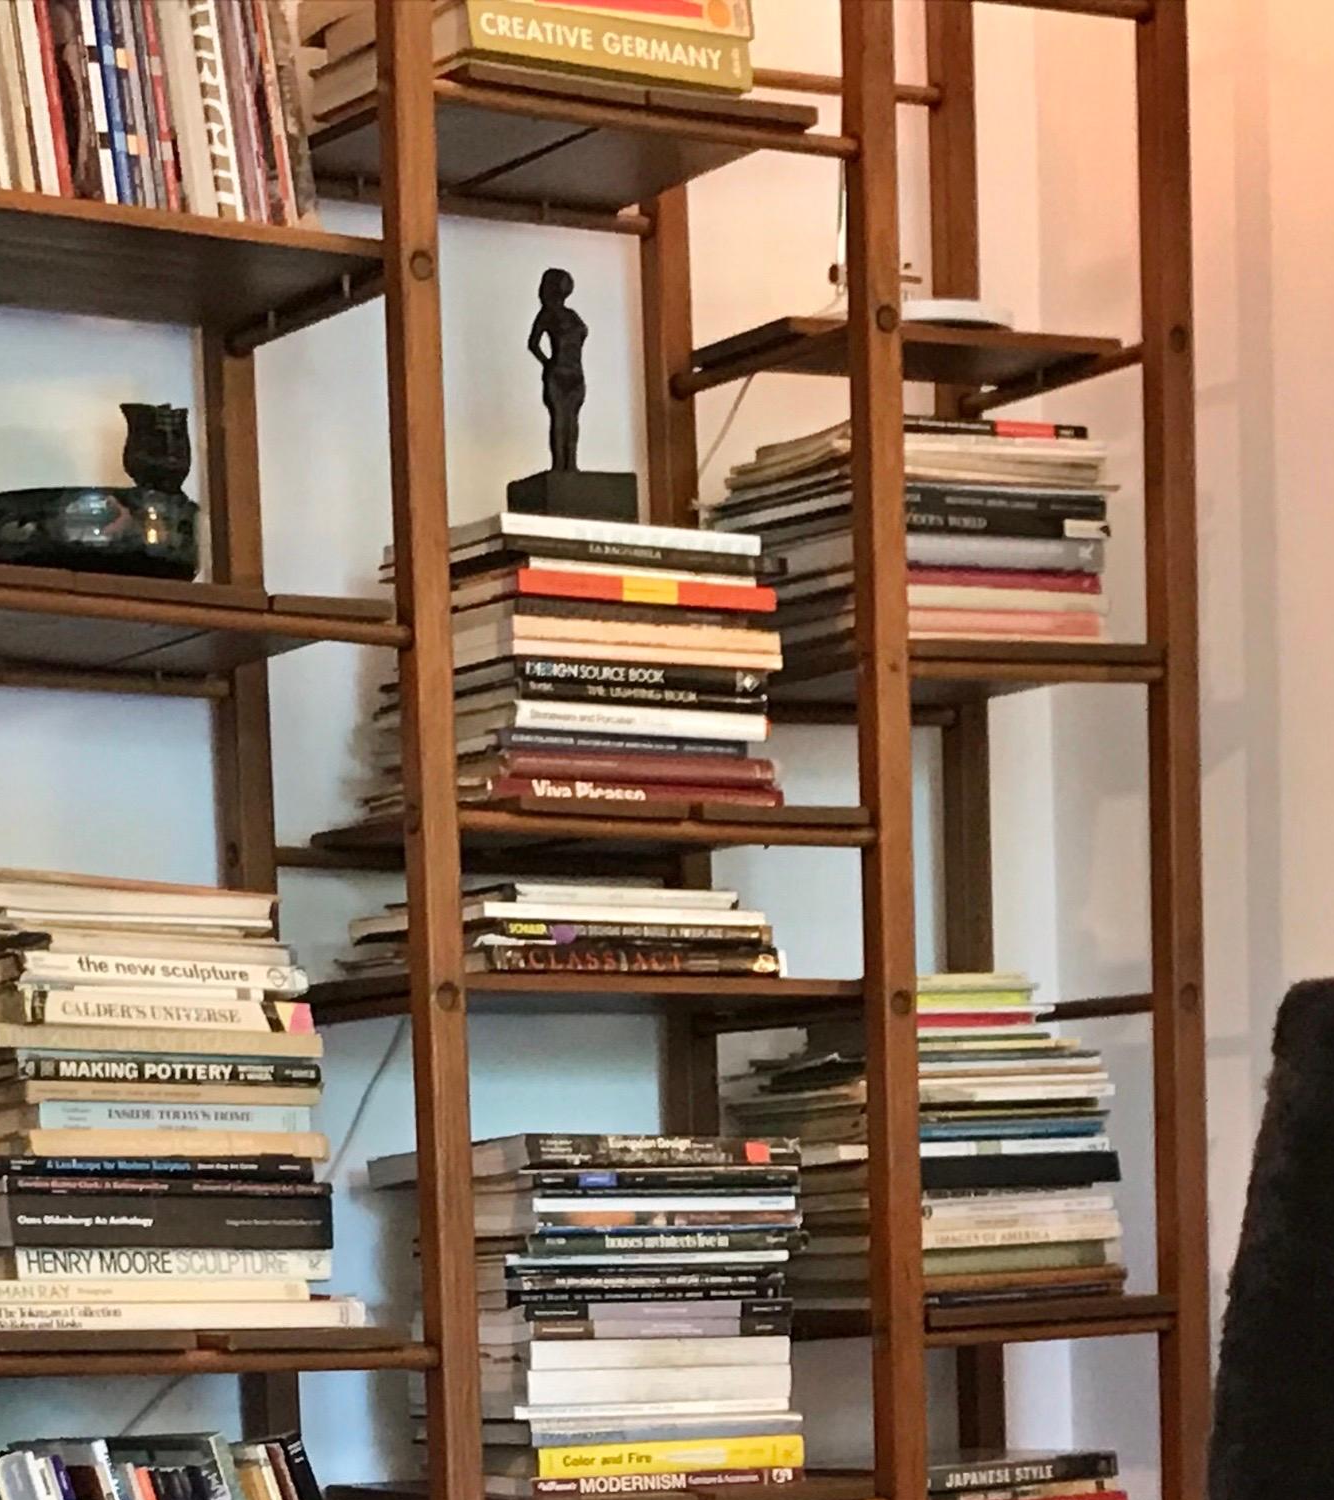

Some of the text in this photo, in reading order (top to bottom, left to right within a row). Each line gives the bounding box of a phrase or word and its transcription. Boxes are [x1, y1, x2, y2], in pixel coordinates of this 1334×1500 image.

[480, 12, 594, 50] CREATIVE
[602, 32, 722, 71] GERMANY
[526, 661, 665, 684] DESIGN SOURCE BOOK
[531, 779, 646, 801] Viva Picasso
[77, 956, 250, 983] the new sculpture
[529, 949, 616, 971] CLASS
[61, 1001, 241, 1023] CALDER'S UNIVERSE
[59, 1061, 232, 1081] MAKING POTTERY
[107, 1108, 154, 1121] INSIDE
[214, 1111, 254, 1123] HOME
[605, 1235, 643, 1249] houses
[645, 1233, 697, 1248] architects
[698, 1232, 714, 1248] live
[27, 1250, 290, 1275] HENRY MOORE SCULPTURE
[37, 1285, 69, 1298] RAY
[70, 1306, 123, 1318] Collection
[563, 1452, 653, 1468] Color and Fire
[580, 1473, 687, 1494] MODERNISM
[945, 1464, 1054, 1489] JAPANESE STYLE
